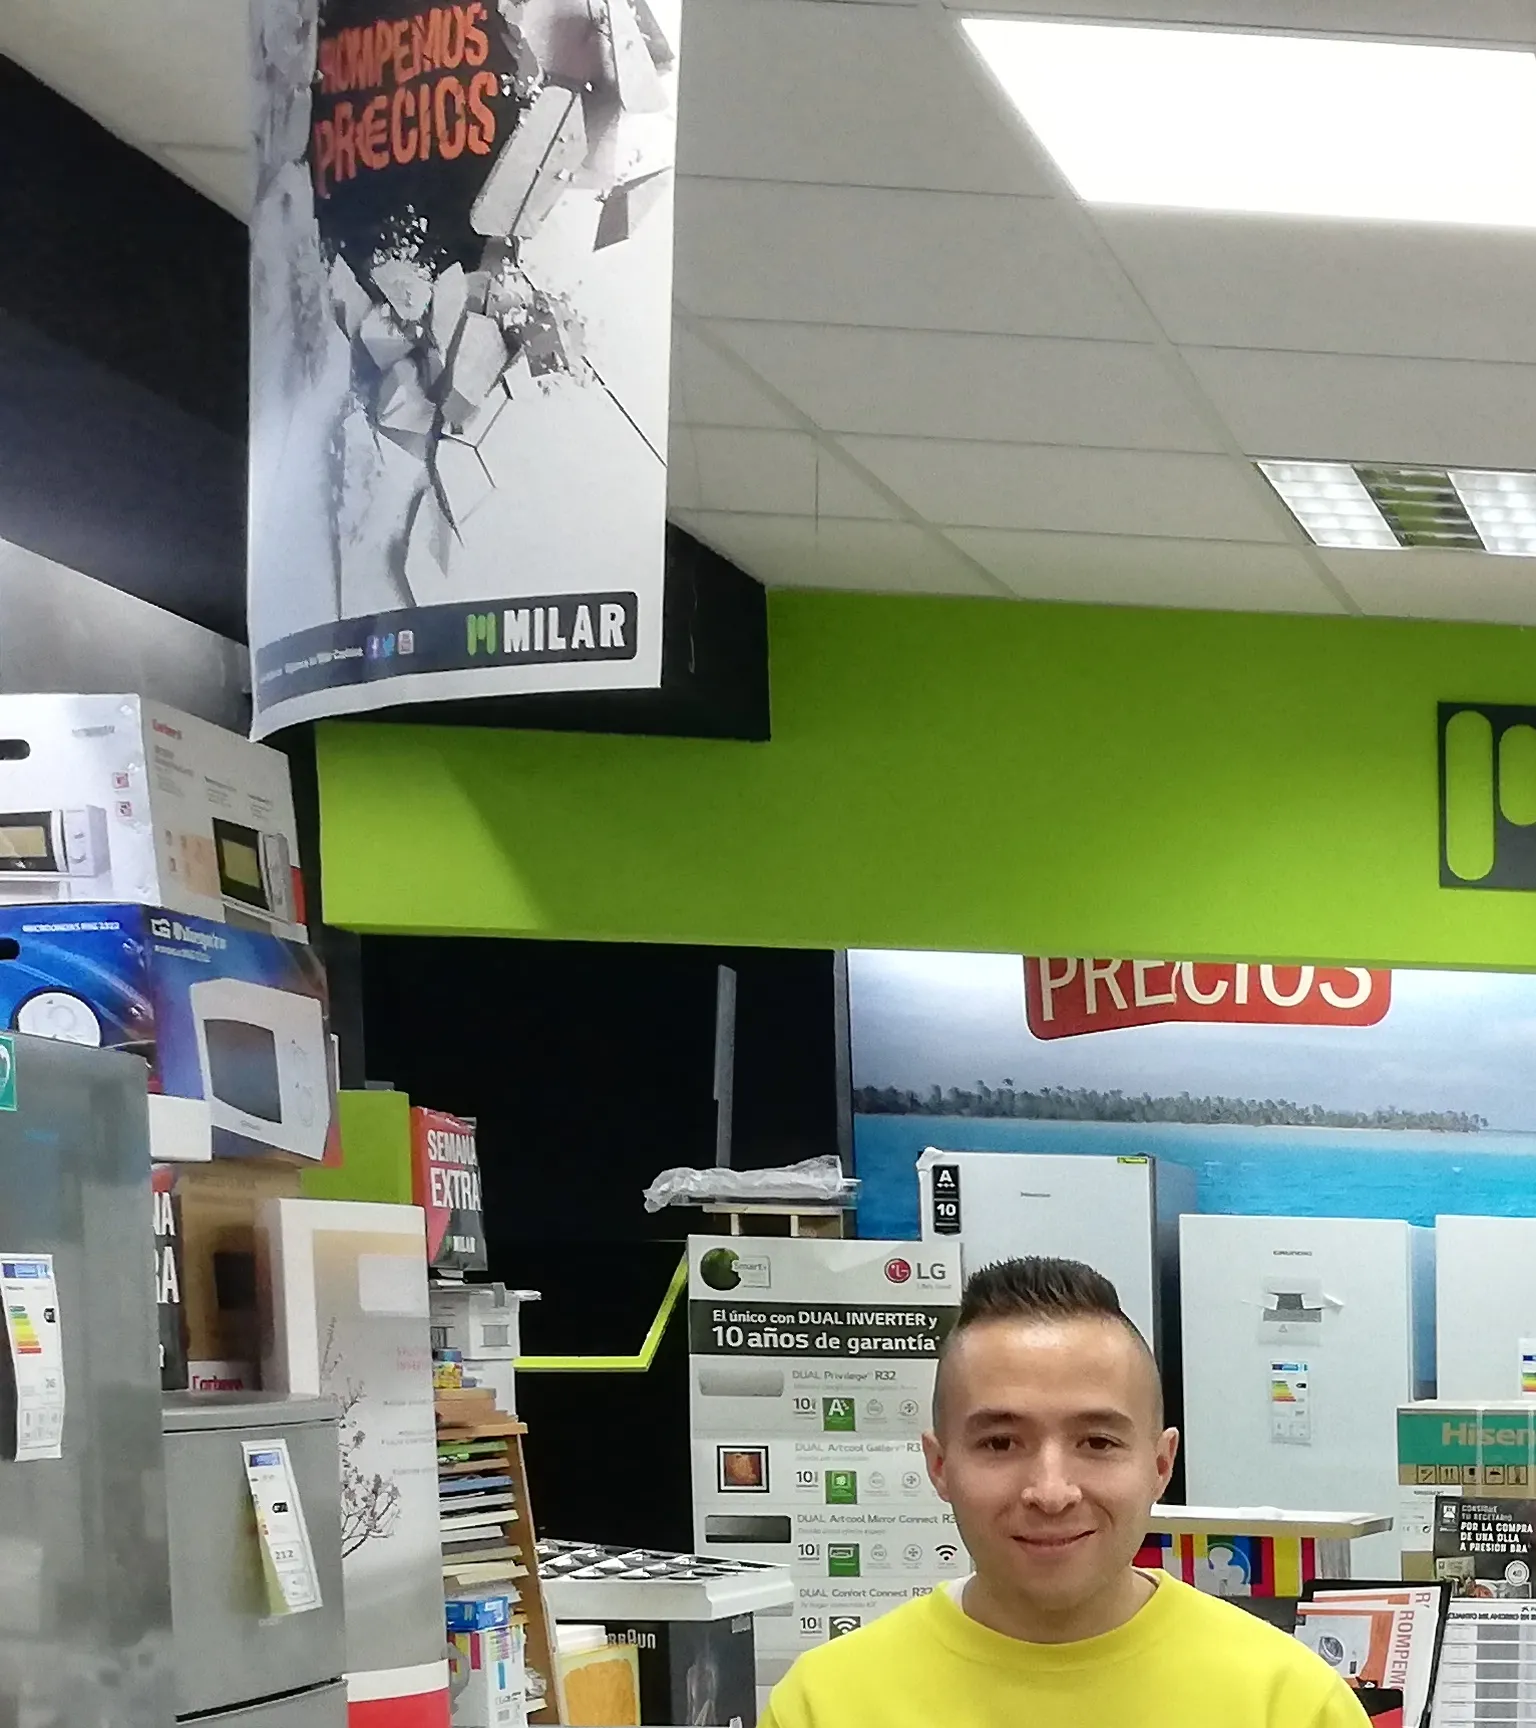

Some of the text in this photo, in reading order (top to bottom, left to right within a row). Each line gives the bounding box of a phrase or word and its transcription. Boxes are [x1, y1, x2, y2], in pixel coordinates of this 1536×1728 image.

[503, 604, 626, 654] MILAR
[430, 1168, 481, 1210] EXTRA
[937, 1203, 957, 1217] 10
[916, 1263, 946, 1281] LG
[712, 1309, 938, 1331] El único con DUAL INVERTER y
[712, 1327, 744, 1347] 10
[749, 1327, 809, 1349] años
[815, 1331, 841, 1350] de
[875, 1371, 896, 1381] R32
[793, 1398, 810, 1410] 10
[907, 1443, 921, 1452] R3
[941, 1514, 957, 1524] R3
[1460, 1521, 1534, 1534] POR LA COMPRA
[1460, 1531, 1520, 1543] DE UNA OLLA
[798, 1544, 815, 1555] 10
[1459, 1542, 1467, 1551] A
[800, 1618, 817, 1629] 10
[1389, 1610, 1415, 1691] ROMPEM
